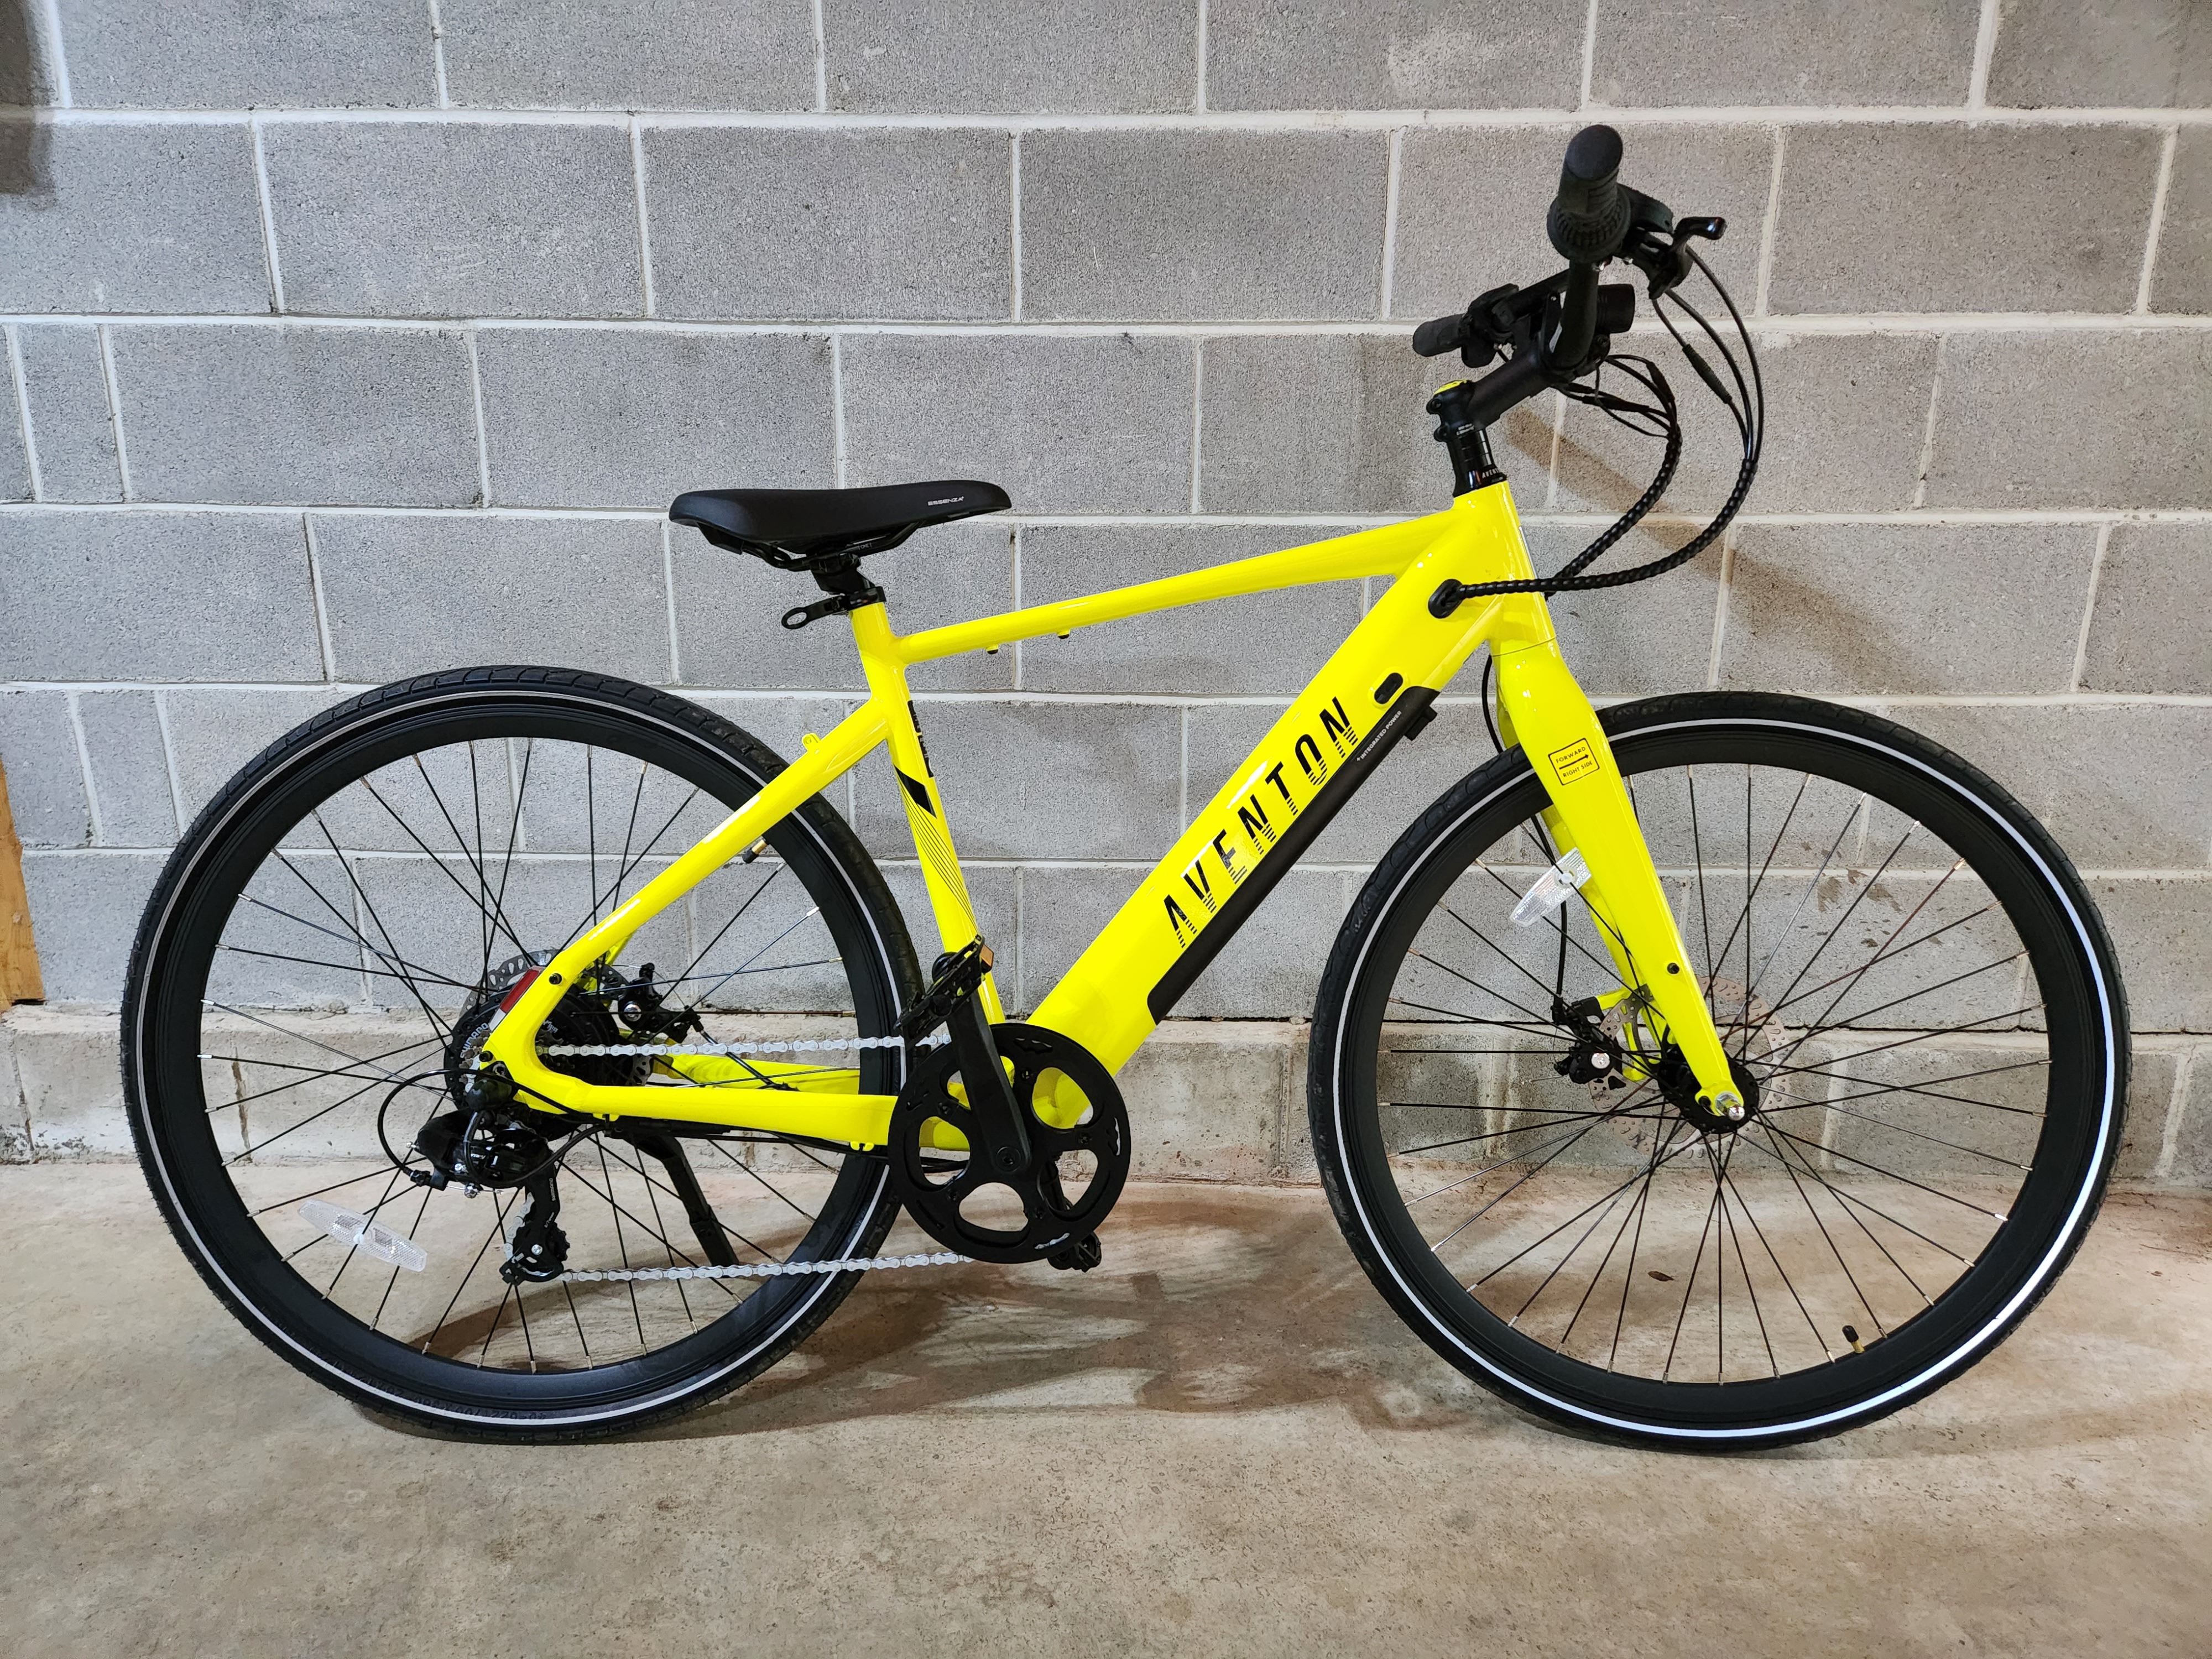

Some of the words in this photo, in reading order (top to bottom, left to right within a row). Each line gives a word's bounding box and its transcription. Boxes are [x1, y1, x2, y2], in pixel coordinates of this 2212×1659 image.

[1360, 729, 1387, 759] INTEGRATED
[1385, 710, 1402, 729] POWER
[1556, 747, 1586, 764] FORWARD
[1562, 766, 1580, 778] RIGHT
[1580, 760, 1593, 769] SIDE
[1164, 696, 1358, 949] AVENTON
